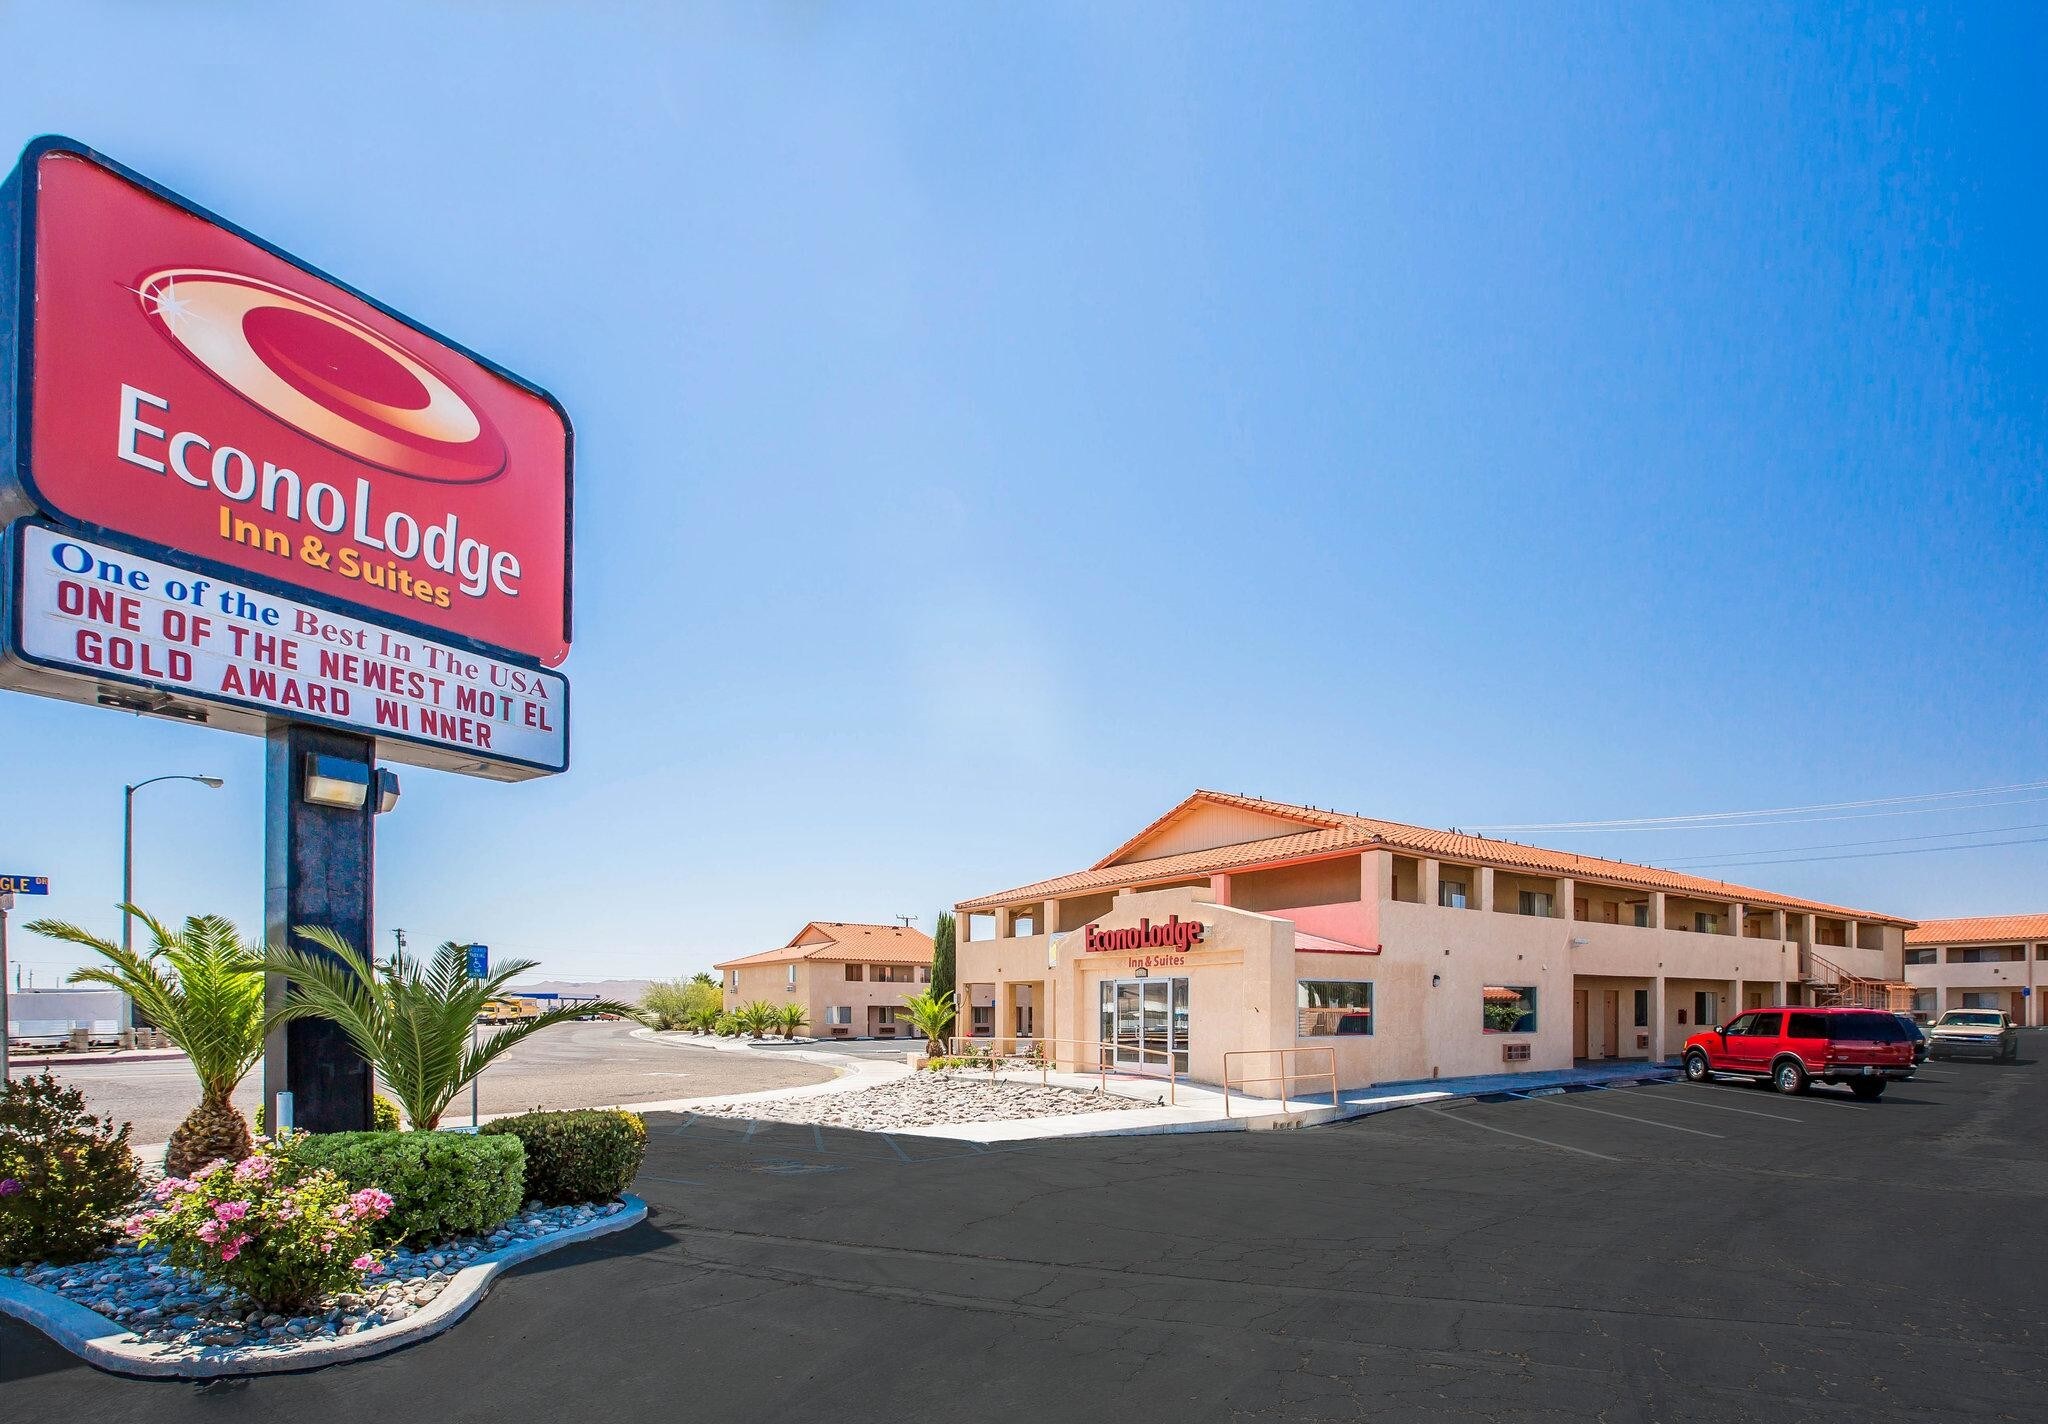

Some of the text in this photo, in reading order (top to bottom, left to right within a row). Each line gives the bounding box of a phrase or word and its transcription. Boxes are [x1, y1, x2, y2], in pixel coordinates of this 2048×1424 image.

[117, 382, 522, 598] EconoLodge
[219, 505, 452, 610] Inn & Suites
[51, 542, 550, 700] One of the Best In The USA
[58, 580, 142, 633] ONE
[162, 609, 212, 648] OF
[227, 624, 299, 671] THE
[320, 649, 446, 705] NEWEST
[75, 629, 193, 683] GOLD
[220, 663, 350, 717] AWARD
[1085, 914, 1205, 953] EconoLodge
[1128, 954, 1185, 969] Inn & Suites
